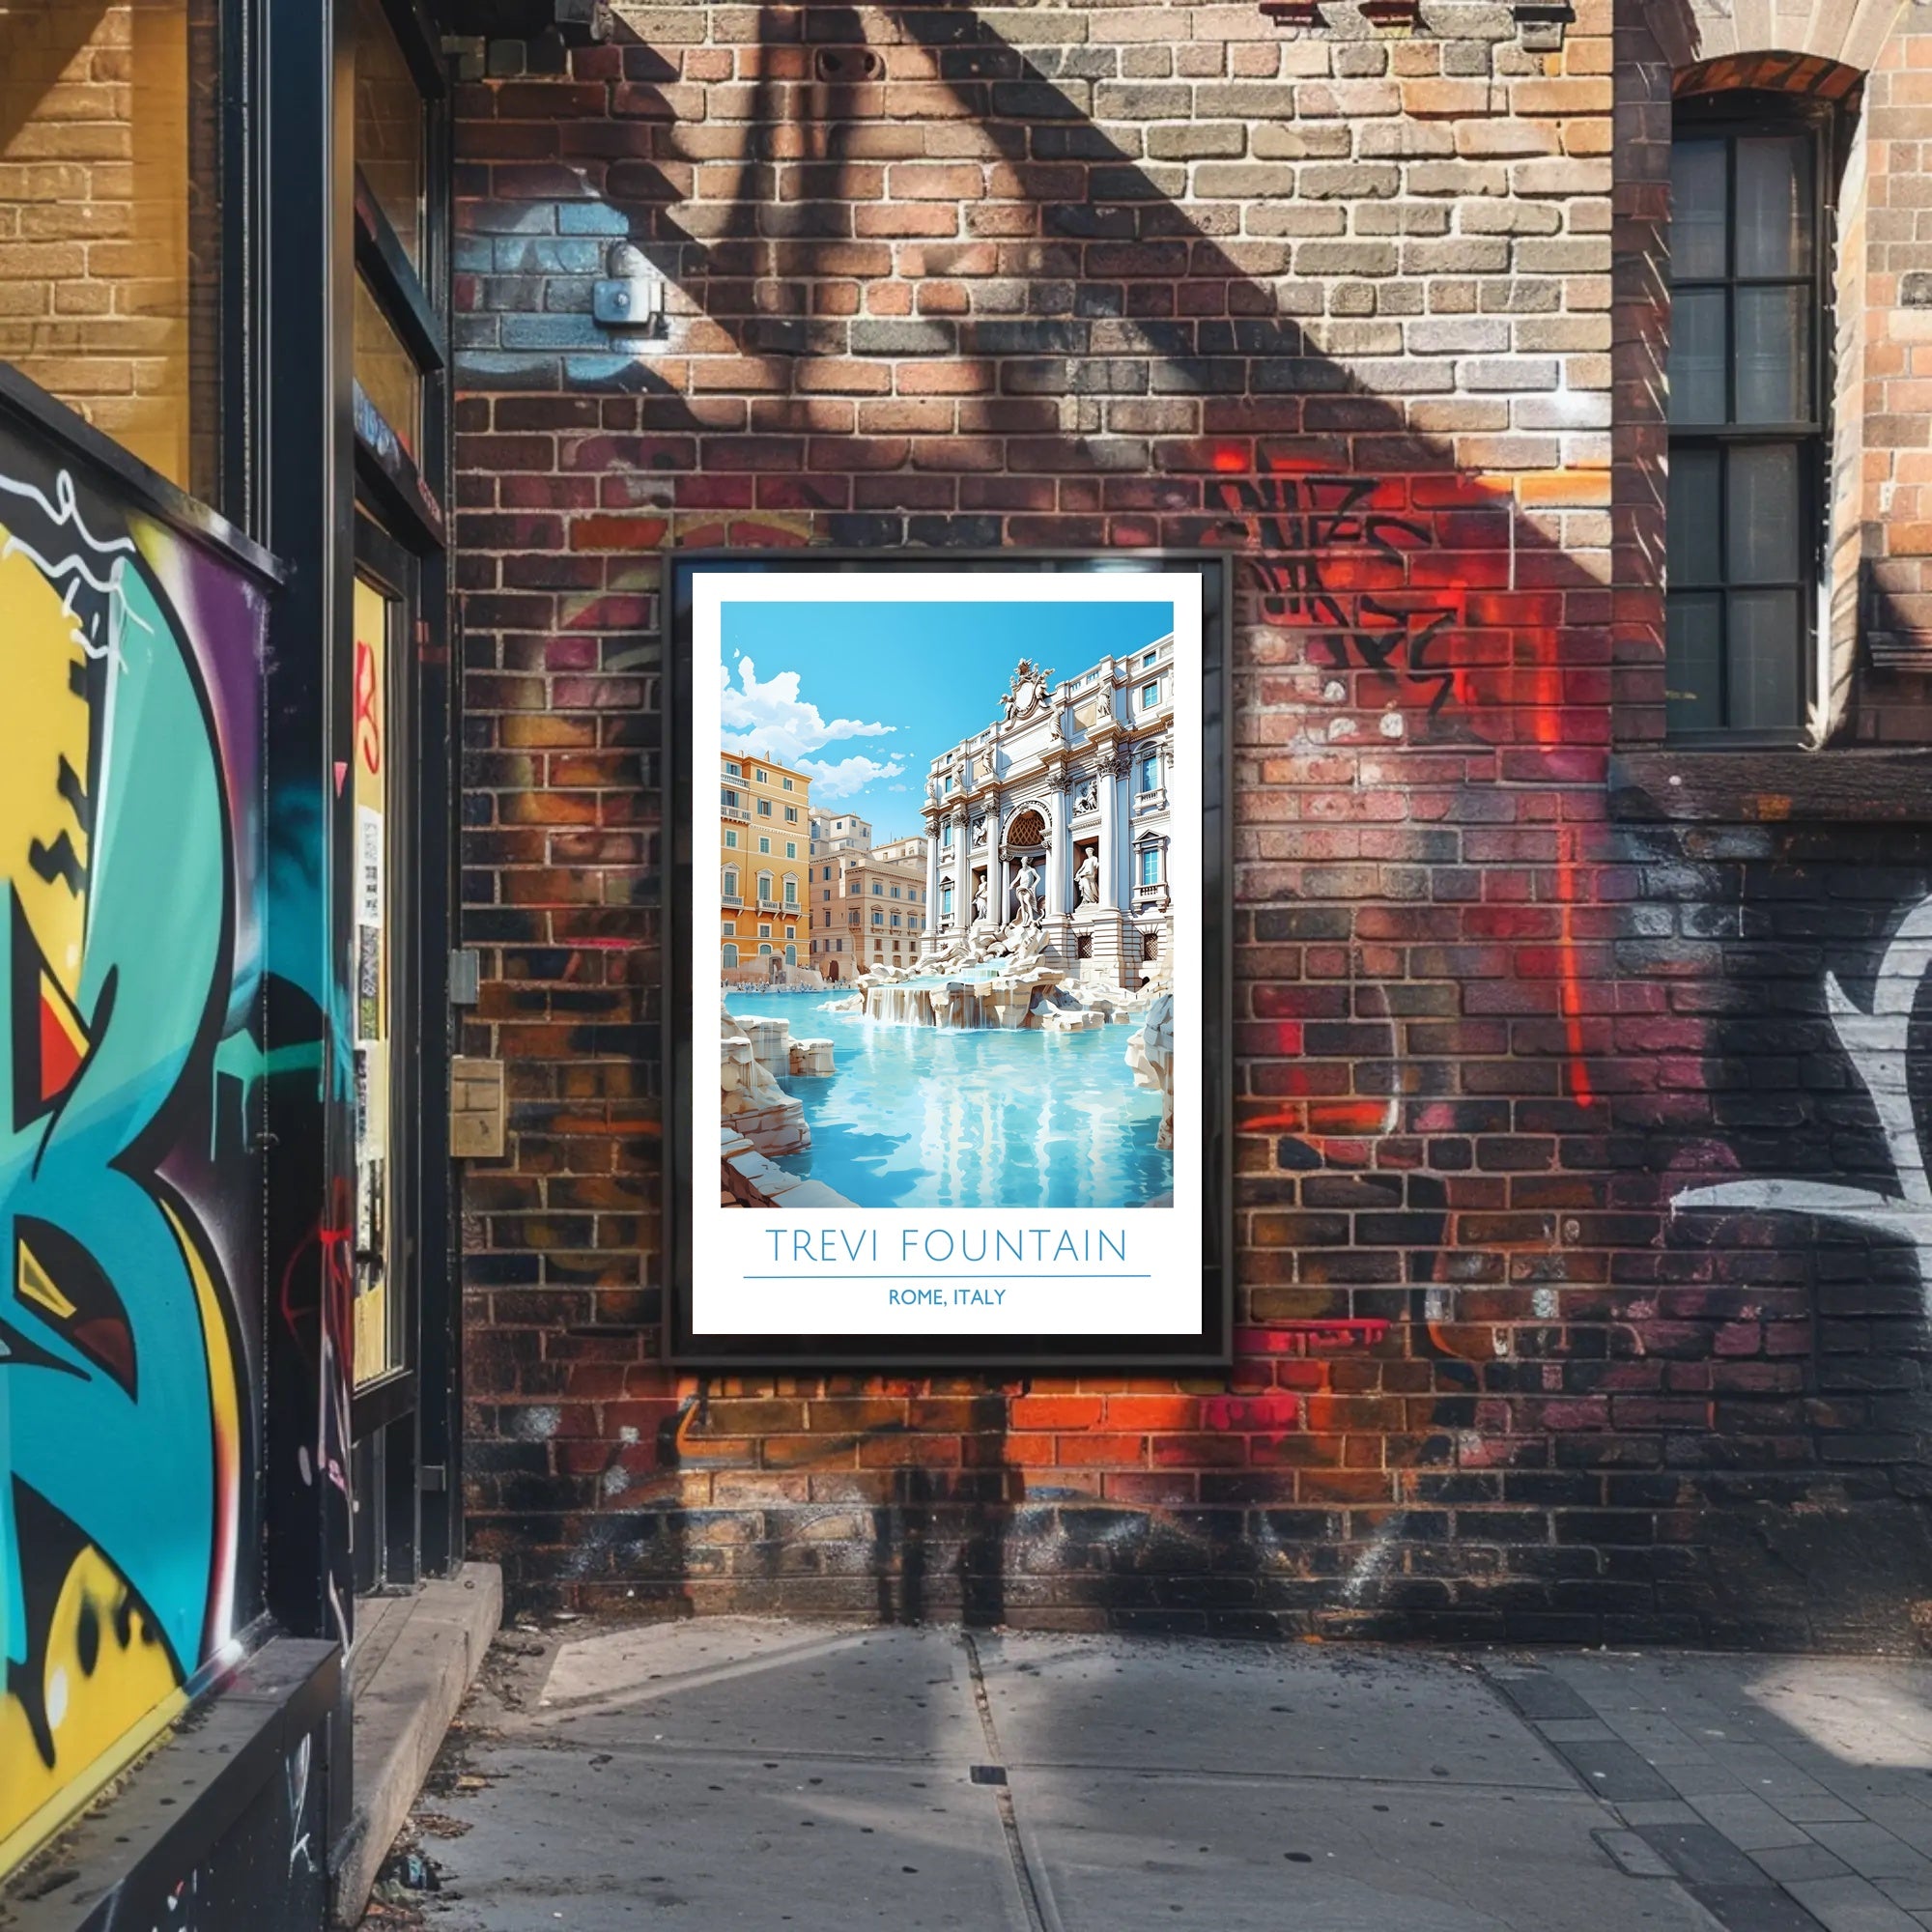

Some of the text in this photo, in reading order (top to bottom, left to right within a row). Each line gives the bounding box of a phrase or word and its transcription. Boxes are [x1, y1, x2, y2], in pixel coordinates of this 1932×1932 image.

[765, 1229, 1125, 1263] TREVI FOUNTAIN
[889, 1289, 1007, 1307] ROME, ITALY
